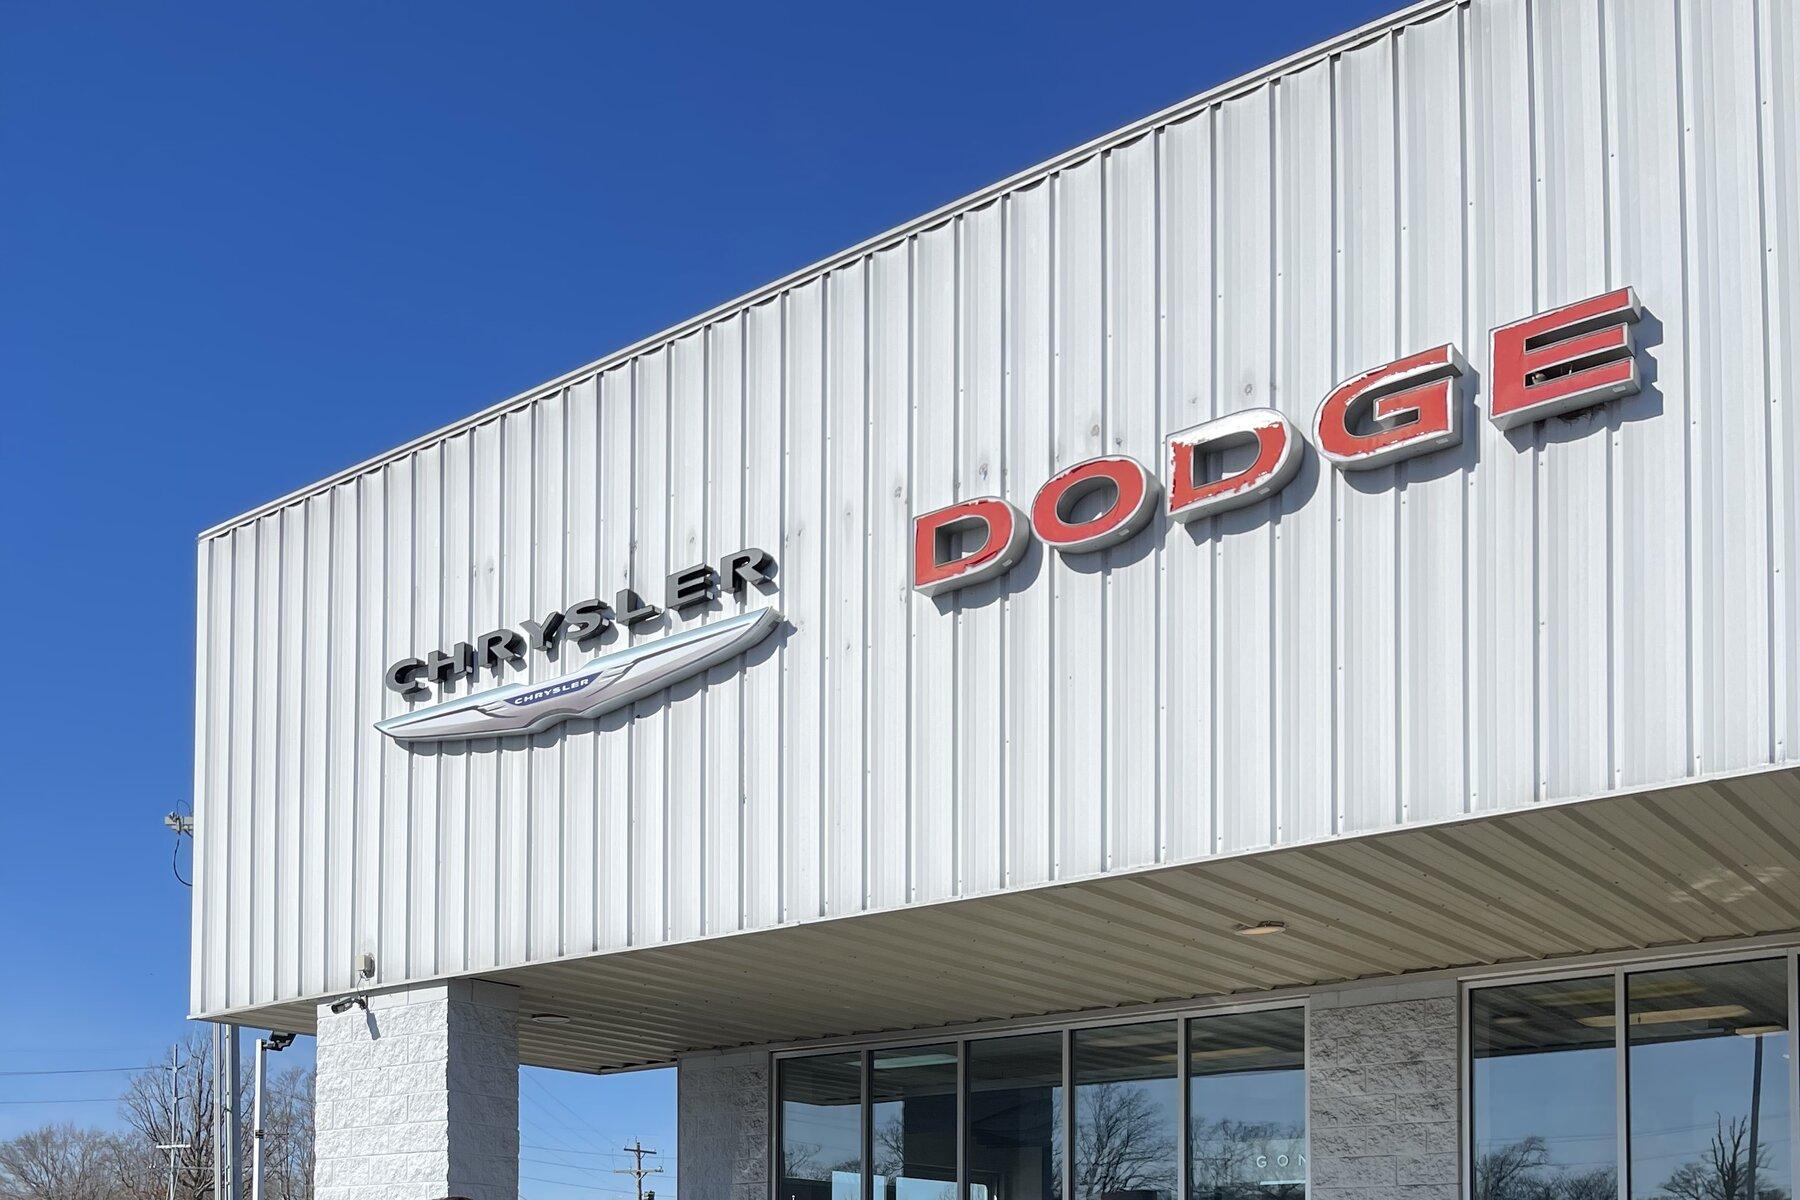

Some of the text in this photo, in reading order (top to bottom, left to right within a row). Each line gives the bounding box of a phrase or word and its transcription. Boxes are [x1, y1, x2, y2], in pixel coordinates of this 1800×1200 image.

[914, 286, 1642, 597] DODGE
[385, 547, 776, 694] CHRYSLER
[514, 679, 590, 705] CHRYSLER
